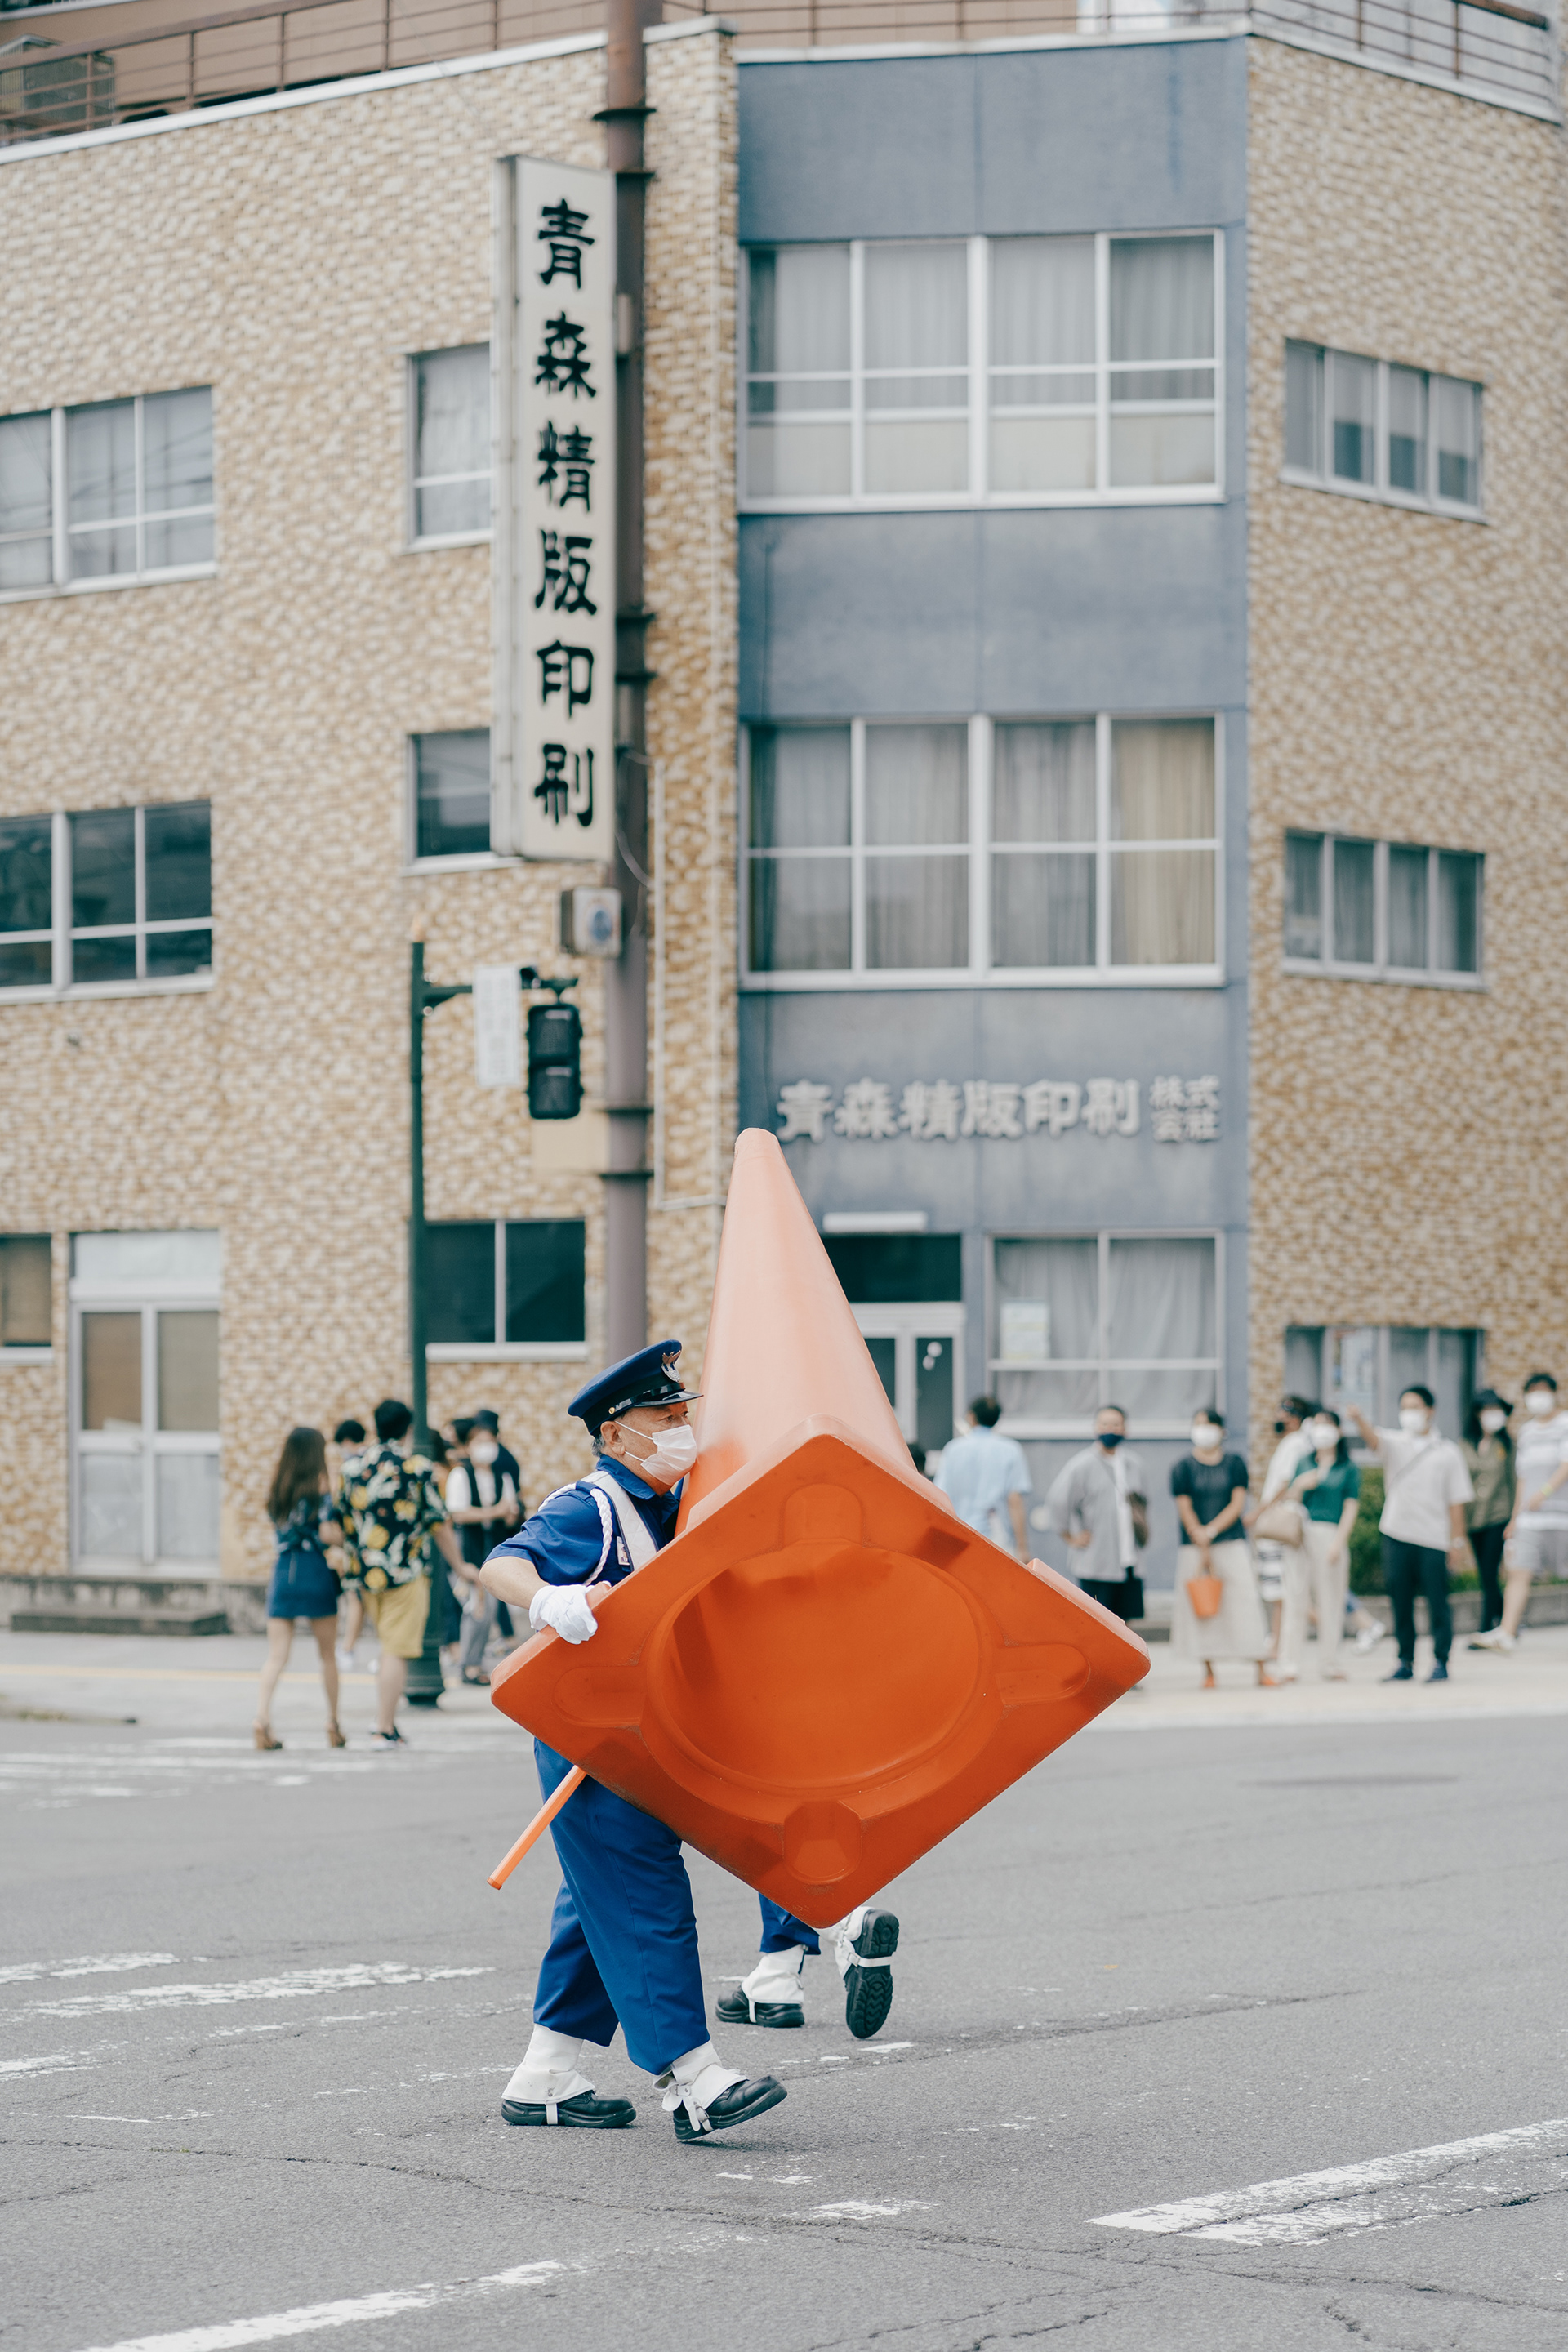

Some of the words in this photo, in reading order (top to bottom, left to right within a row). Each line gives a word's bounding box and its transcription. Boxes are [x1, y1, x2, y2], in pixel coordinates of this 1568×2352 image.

[534, 198, 596, 828] 青森精版印刷
[777, 1078, 1141, 1143] 青森精版印刷
